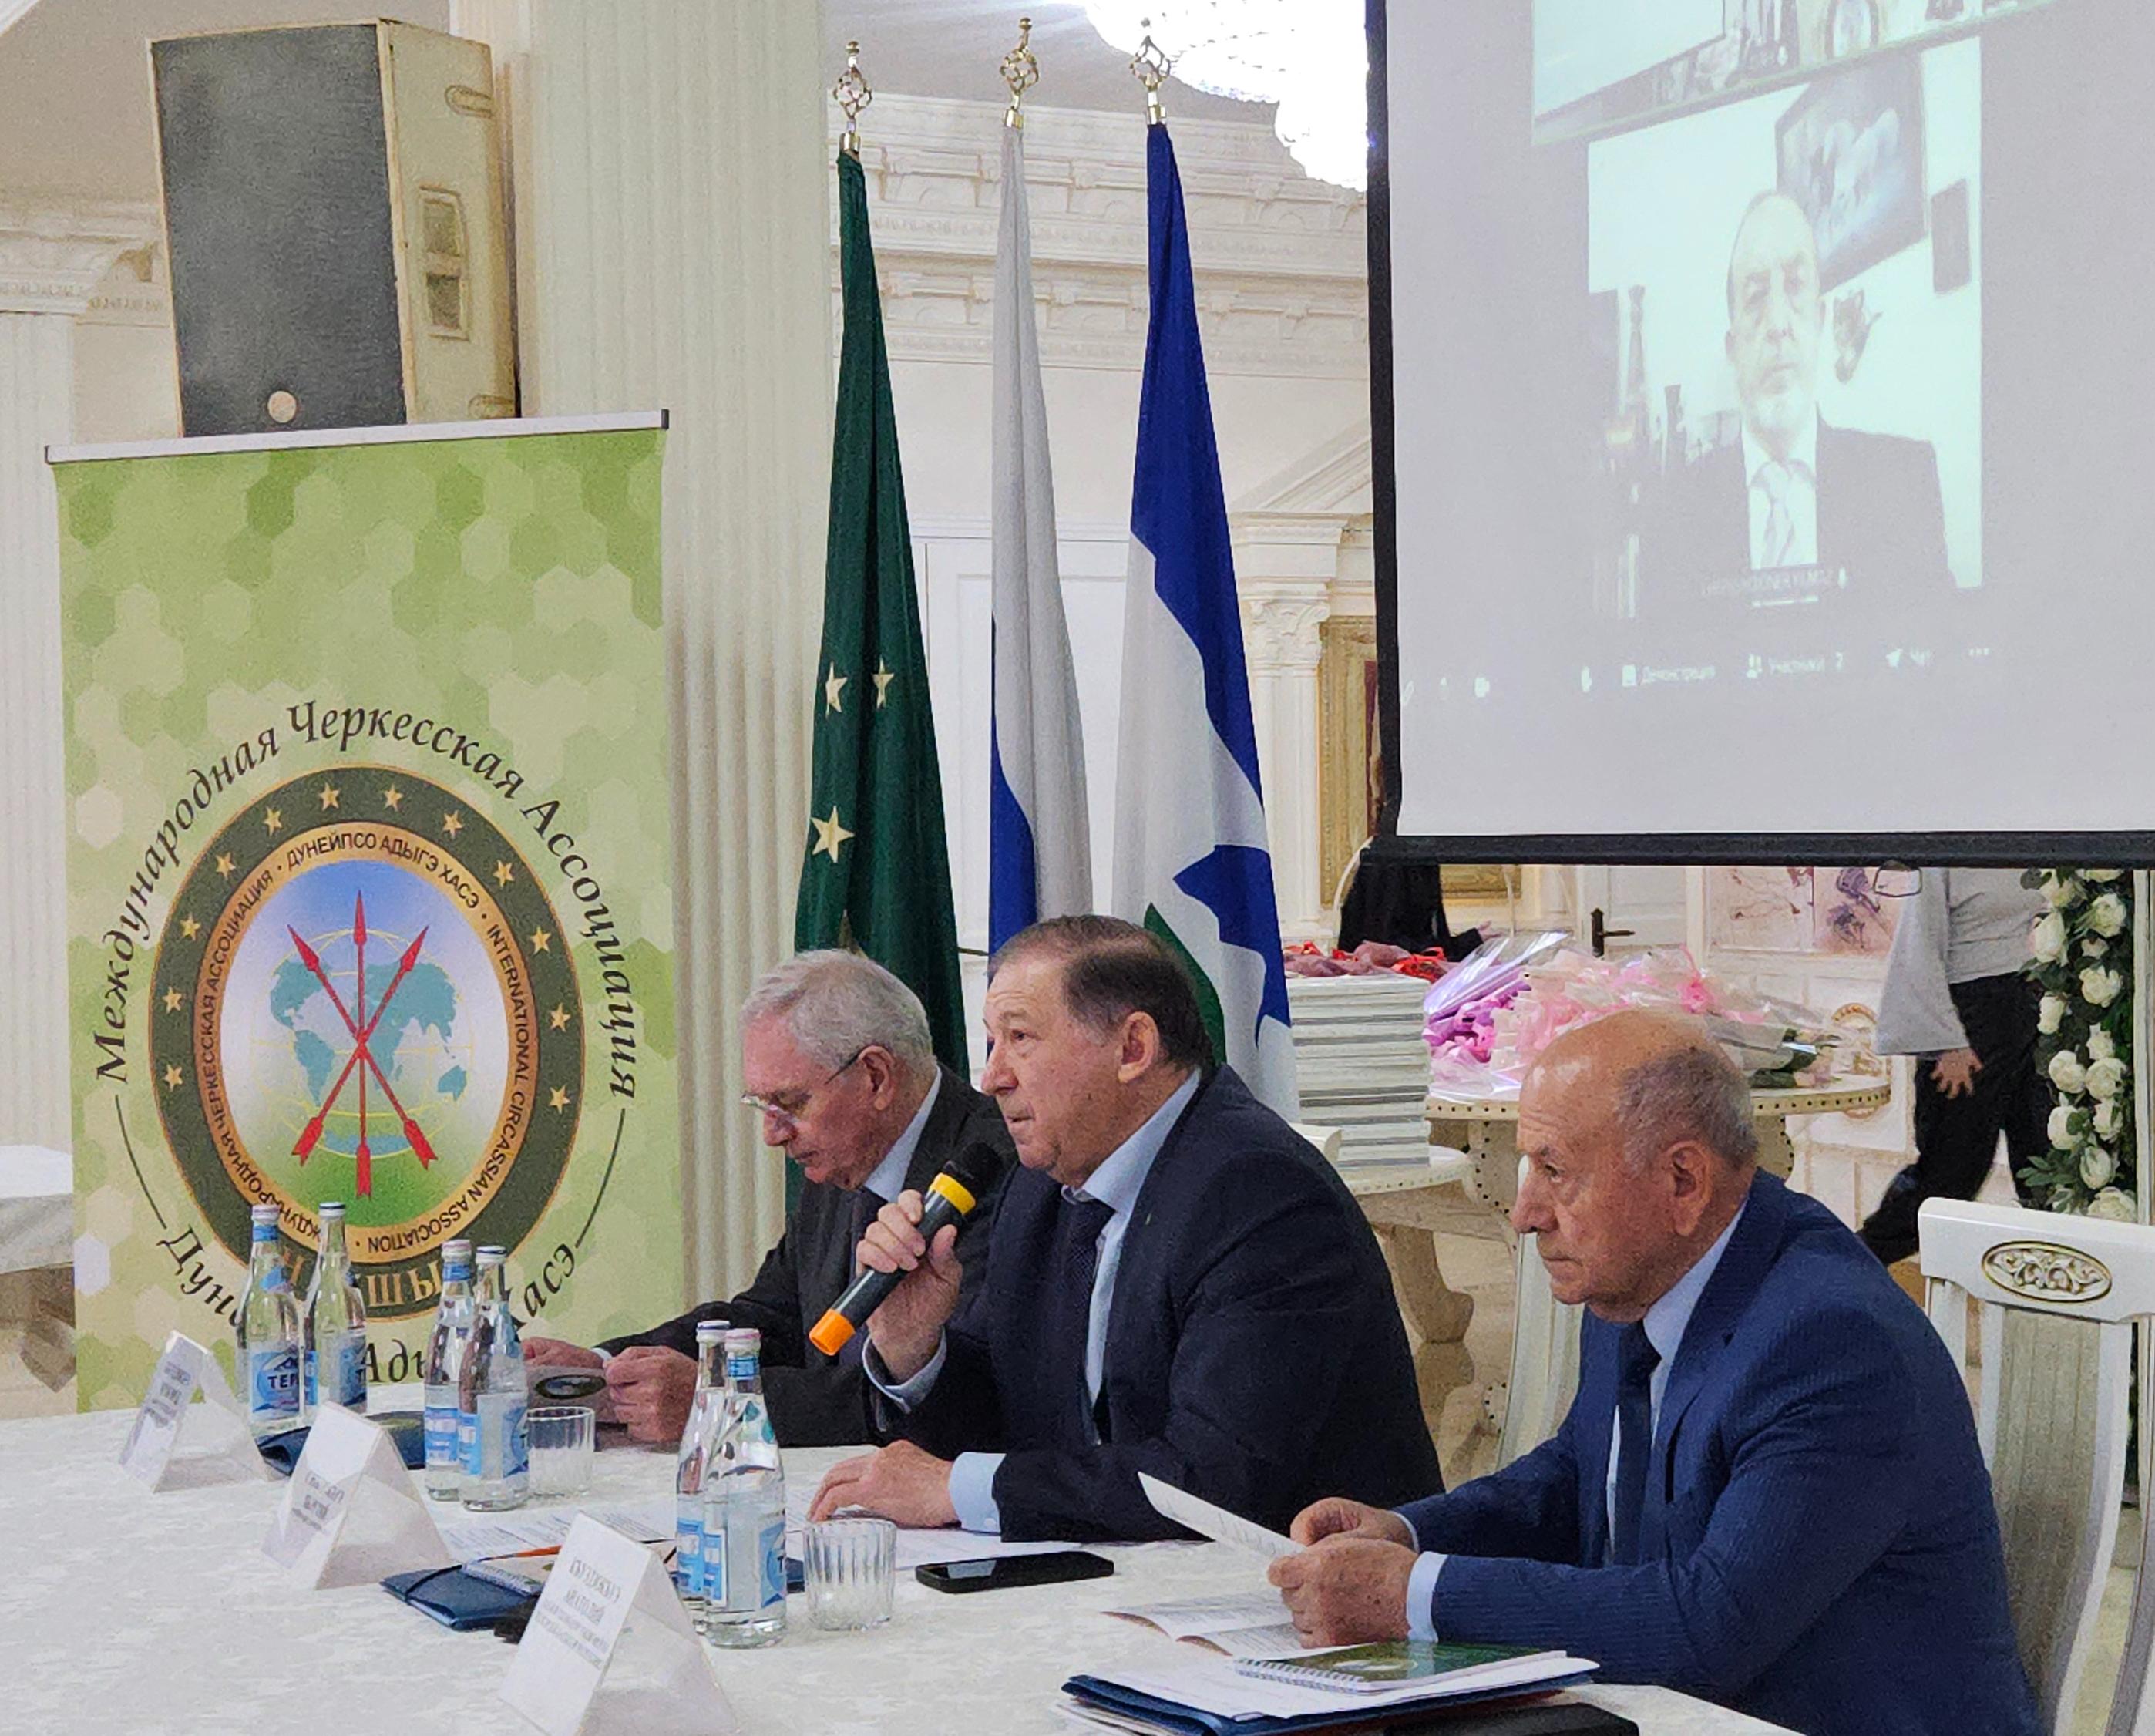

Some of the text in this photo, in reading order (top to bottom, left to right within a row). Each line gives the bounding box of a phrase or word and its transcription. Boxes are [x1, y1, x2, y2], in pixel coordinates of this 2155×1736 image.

[96, 700, 637, 1098] Международная Черкесская Ассоциация
[207, 870, 274, 992] АССОЦИАЦИЯ
[287, 830, 480, 909] ДУНЕЙПСО АДЫГЭ ХАСЭ
[200, 994, 227, 1129] ЧЕРКЕССКАЯ
[368, 924, 530, 1253] INTERNATIONAL CIRCASSIAN ASSOCIATION
